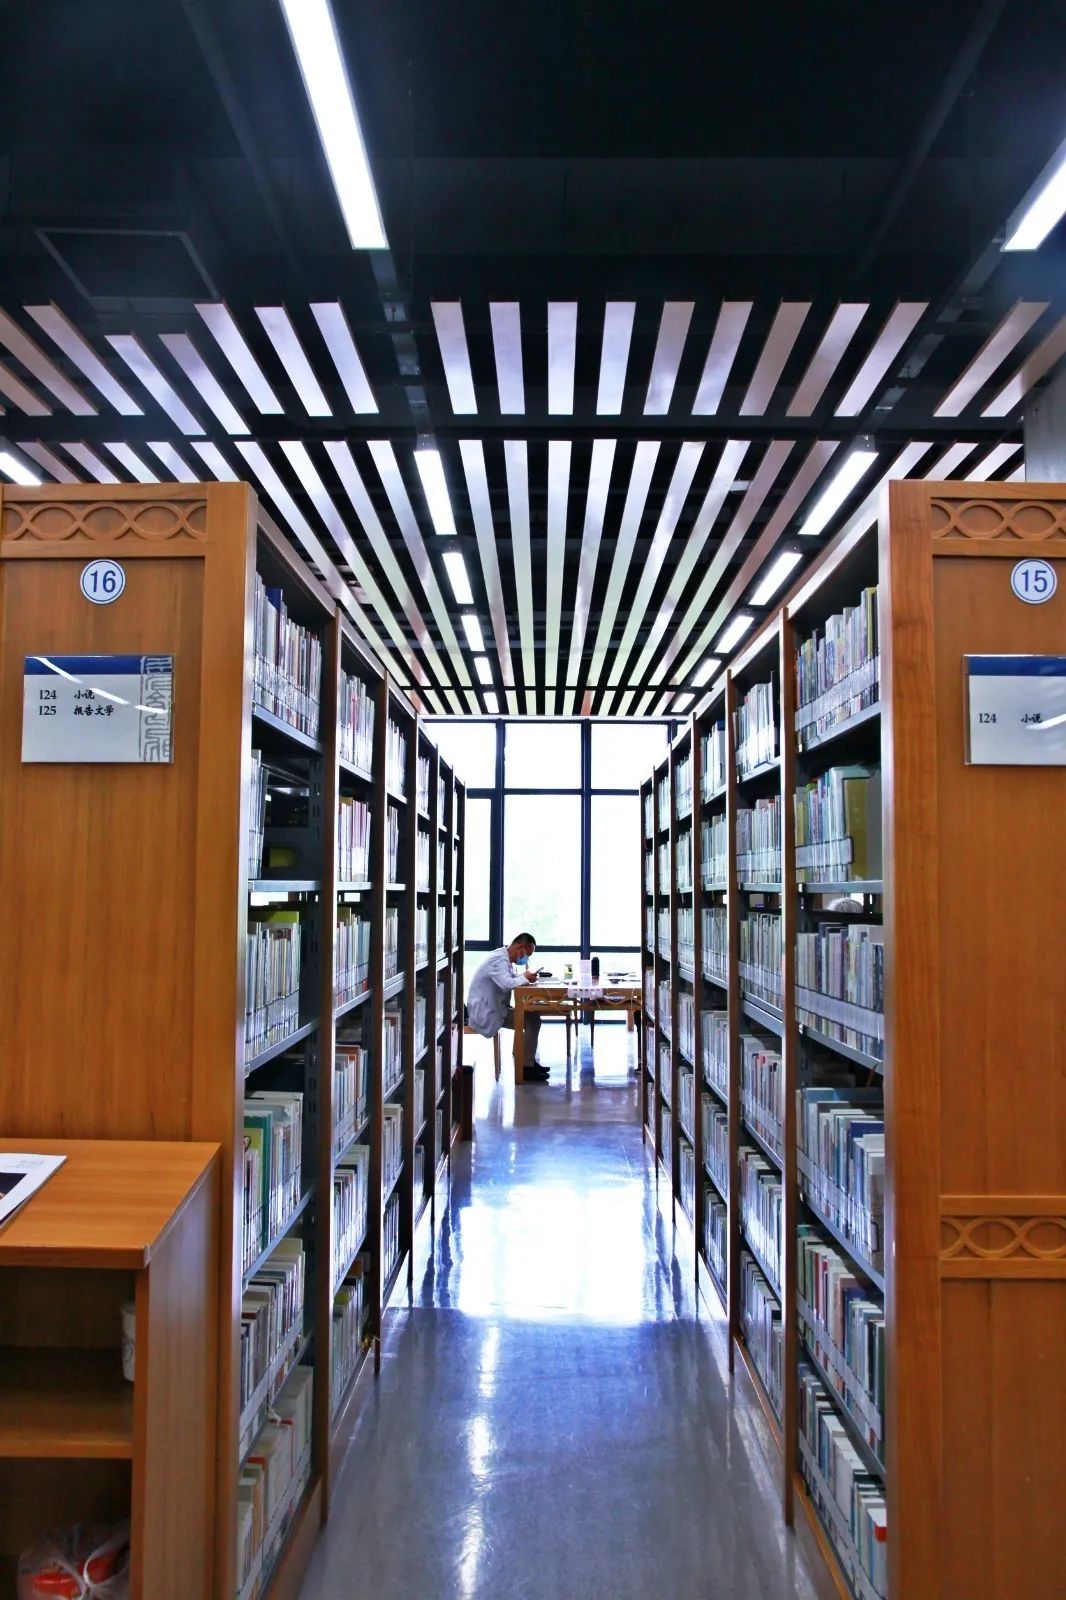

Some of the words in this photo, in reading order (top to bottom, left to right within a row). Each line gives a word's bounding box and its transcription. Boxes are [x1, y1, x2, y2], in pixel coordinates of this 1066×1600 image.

[90, 570, 116, 592] 16
[1021, 570, 1047, 592] 15
[74, 689, 95, 700] 小说
[74, 705, 114, 716] 报告文学
[1021, 713, 1043, 724] 小说
